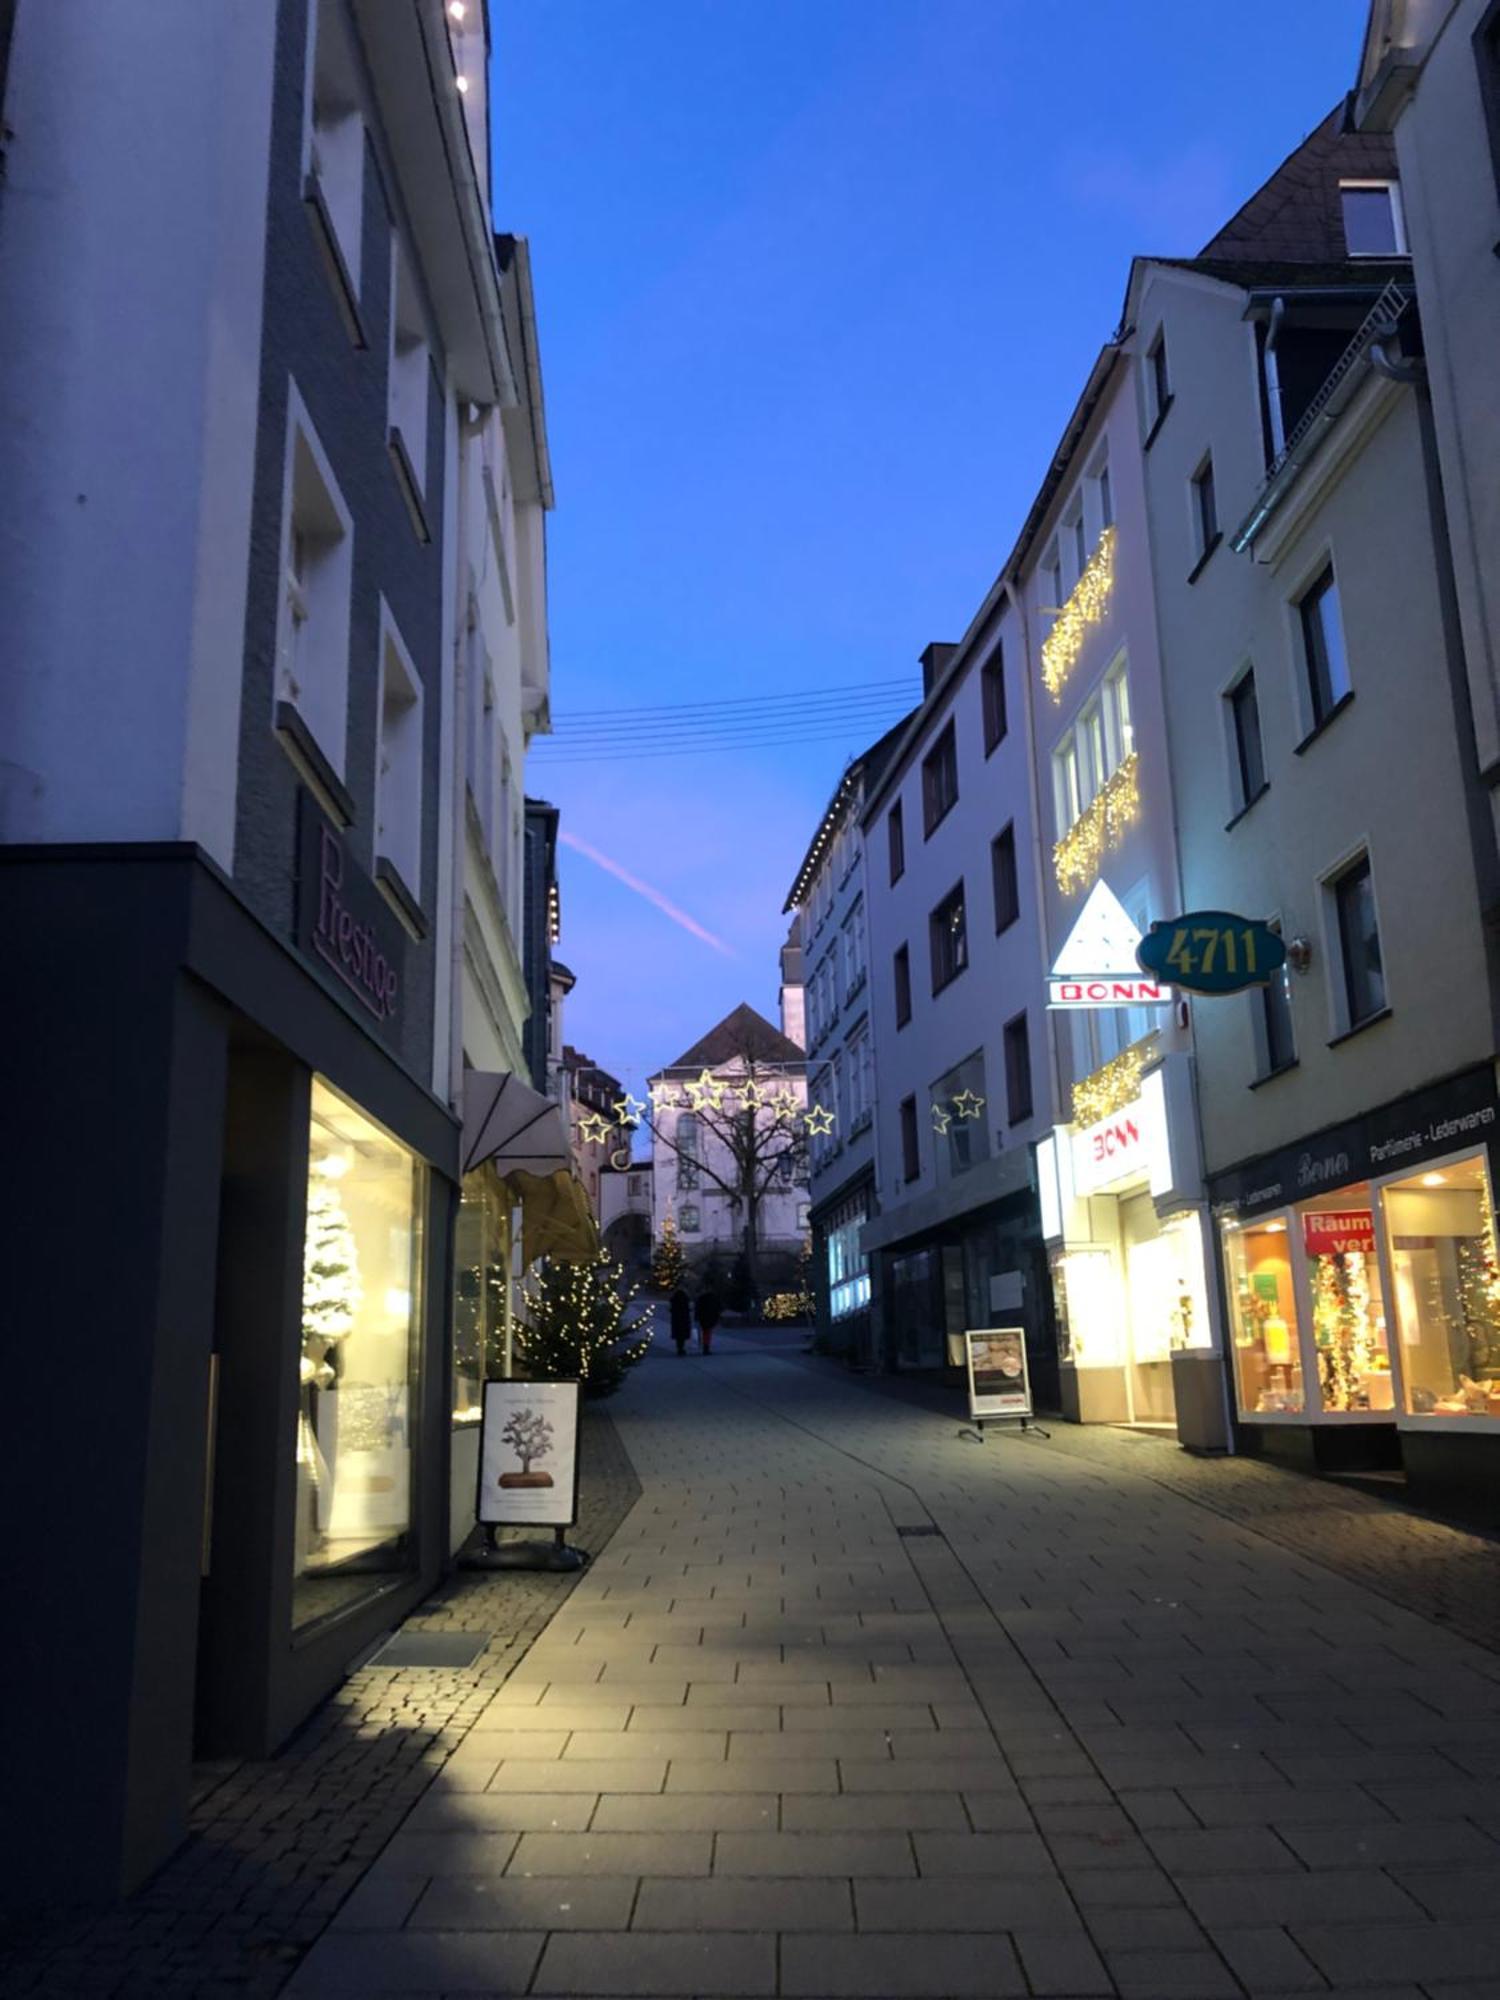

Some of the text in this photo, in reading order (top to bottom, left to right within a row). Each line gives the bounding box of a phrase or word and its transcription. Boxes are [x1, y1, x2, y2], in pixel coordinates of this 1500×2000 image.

[313, 822, 398, 1020] Prestige
[1165, 927, 1257, 975] 4711
[1060, 983, 1160, 1000] BONN
[1369, 1130, 1422, 1163] Parfümerie
[1429, 1106, 1496, 1142] Lederwaren
[1310, 1215, 1374, 1233] Räum
